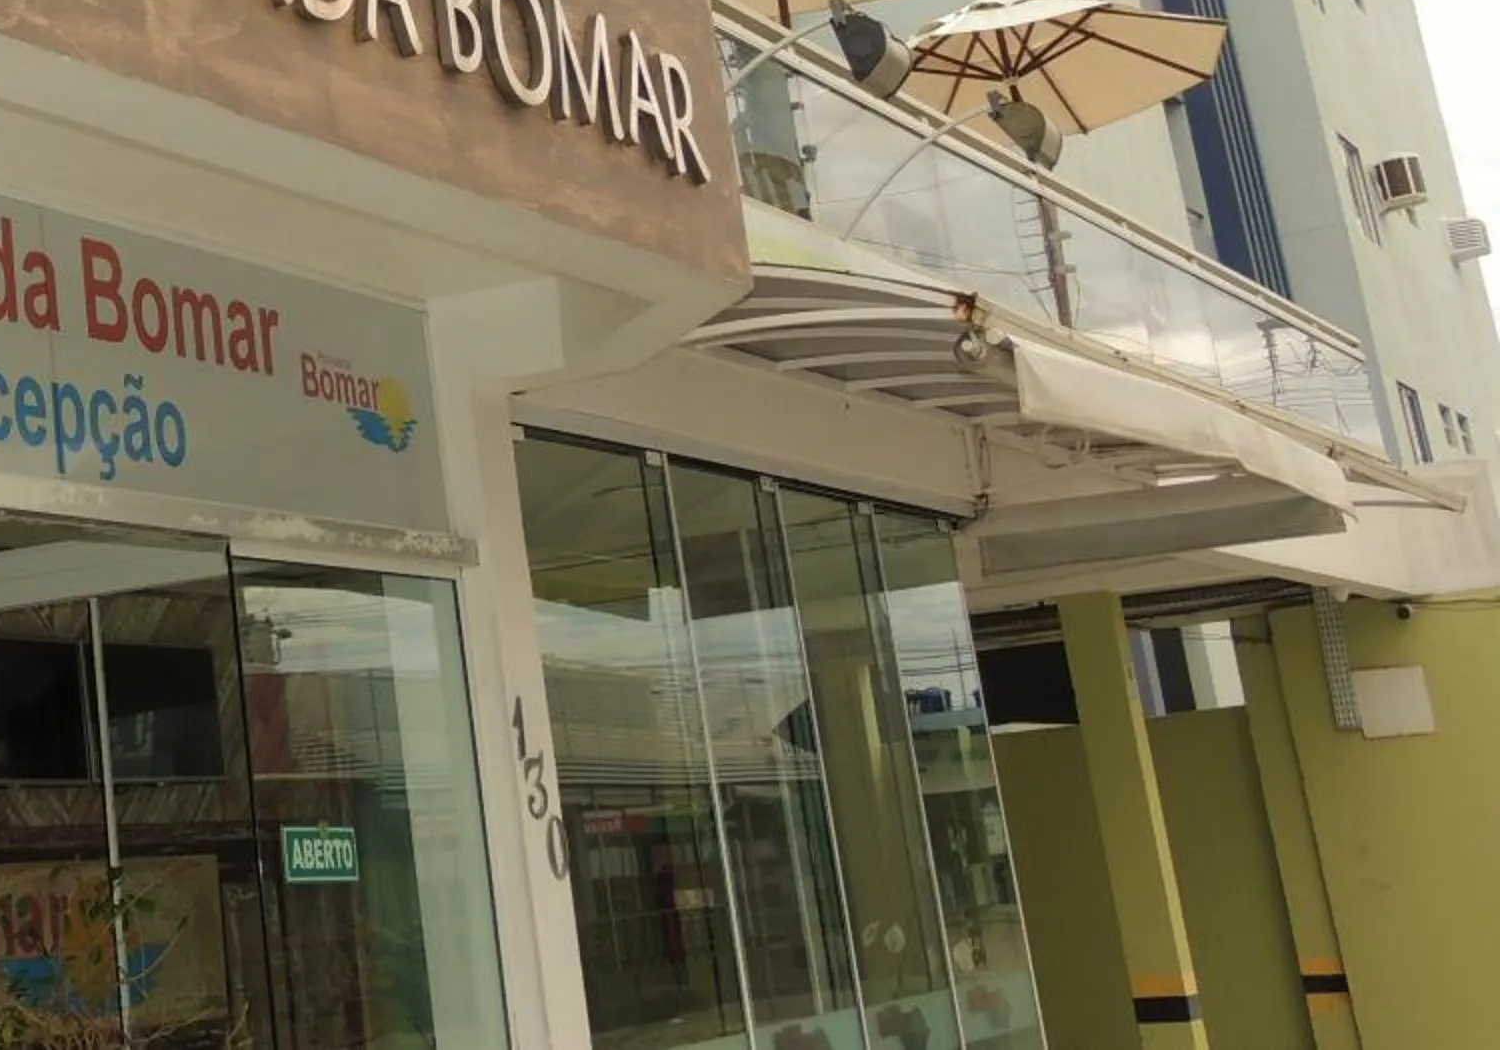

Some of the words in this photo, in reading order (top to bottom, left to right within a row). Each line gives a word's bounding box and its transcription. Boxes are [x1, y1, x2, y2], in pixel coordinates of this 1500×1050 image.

[80, 235, 280, 376] Bomar
[300, 352, 380, 411] Bomar
[511, 695, 571, 881] 130
[291, 837, 354, 870] ABERTO
